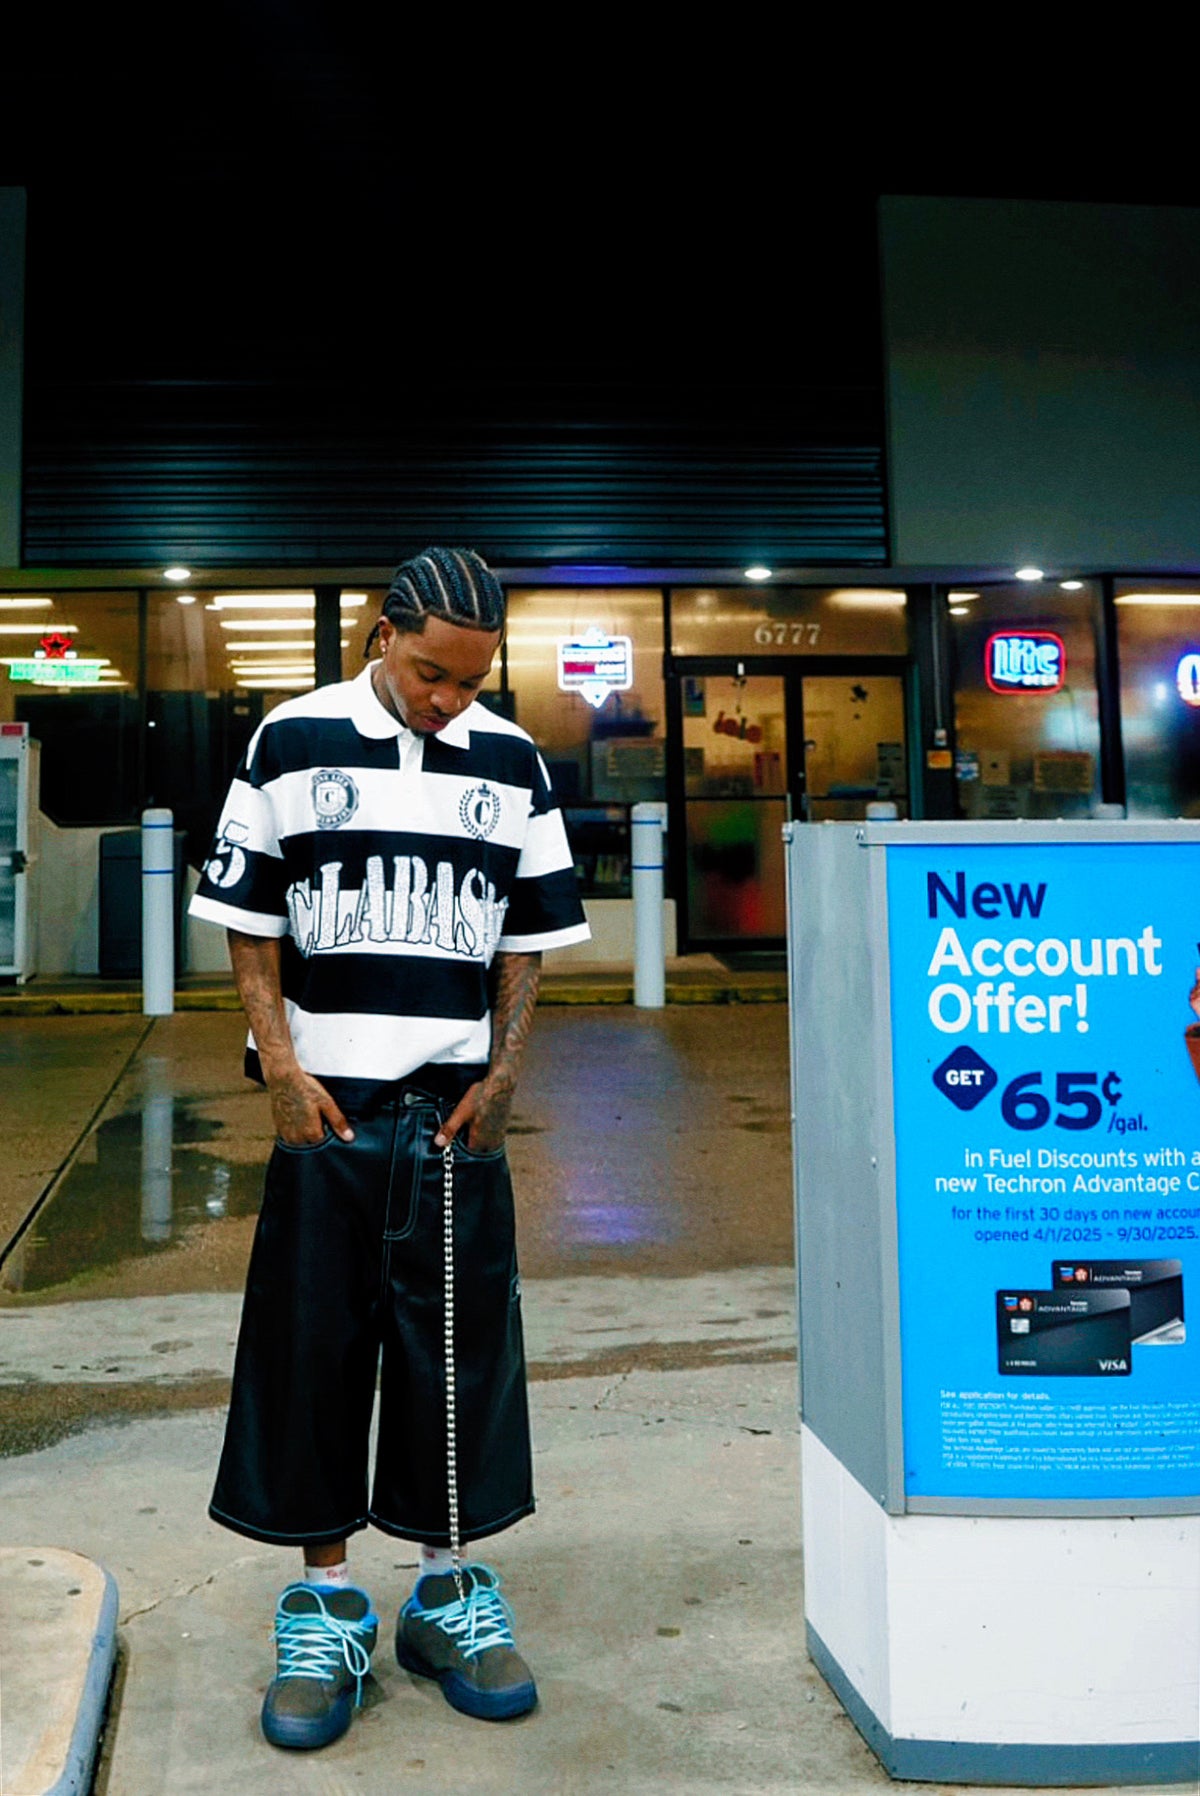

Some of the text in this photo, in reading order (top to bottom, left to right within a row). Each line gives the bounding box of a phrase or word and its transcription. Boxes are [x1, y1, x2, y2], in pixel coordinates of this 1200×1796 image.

[754, 623, 820, 645] 6777
[992, 638, 1060, 683] Lite
[474, 800, 491, 826] C
[207, 819, 249, 889] 5
[927, 871, 1047, 919] New
[927, 925, 1163, 977] Account
[928, 982, 1089, 1033] Offer!
[945, 1069, 985, 1086] GET
[964, 1148, 983, 1168] in
[990, 1148, 1031, 1168] Fuel
[1037, 1148, 1138, 1168] Discounts
[1143, 1147, 1186, 1167] with
[935, 1177, 977, 1193] new
[983, 1173, 1066, 1193] Techron
[1073, 1173, 1181, 1196] Advantage
[952, 1206, 972, 1220] for
[977, 1207, 1001, 1221] the
[1005, 1207, 1035, 1221] first
[1039, 1207, 1060, 1221] 30
[1064, 1208, 1098, 1224] days
[1102, 1209, 1120, 1221] on
[1124, 1209, 1152, 1220] new
[975, 1228, 1029, 1243] opened
[1033, 1227, 1102, 1243] 4/1/2025
[1117, 1225, 1199, 1243] 9/30/2025.
[1099, 1359, 1127, 1371] VISA
